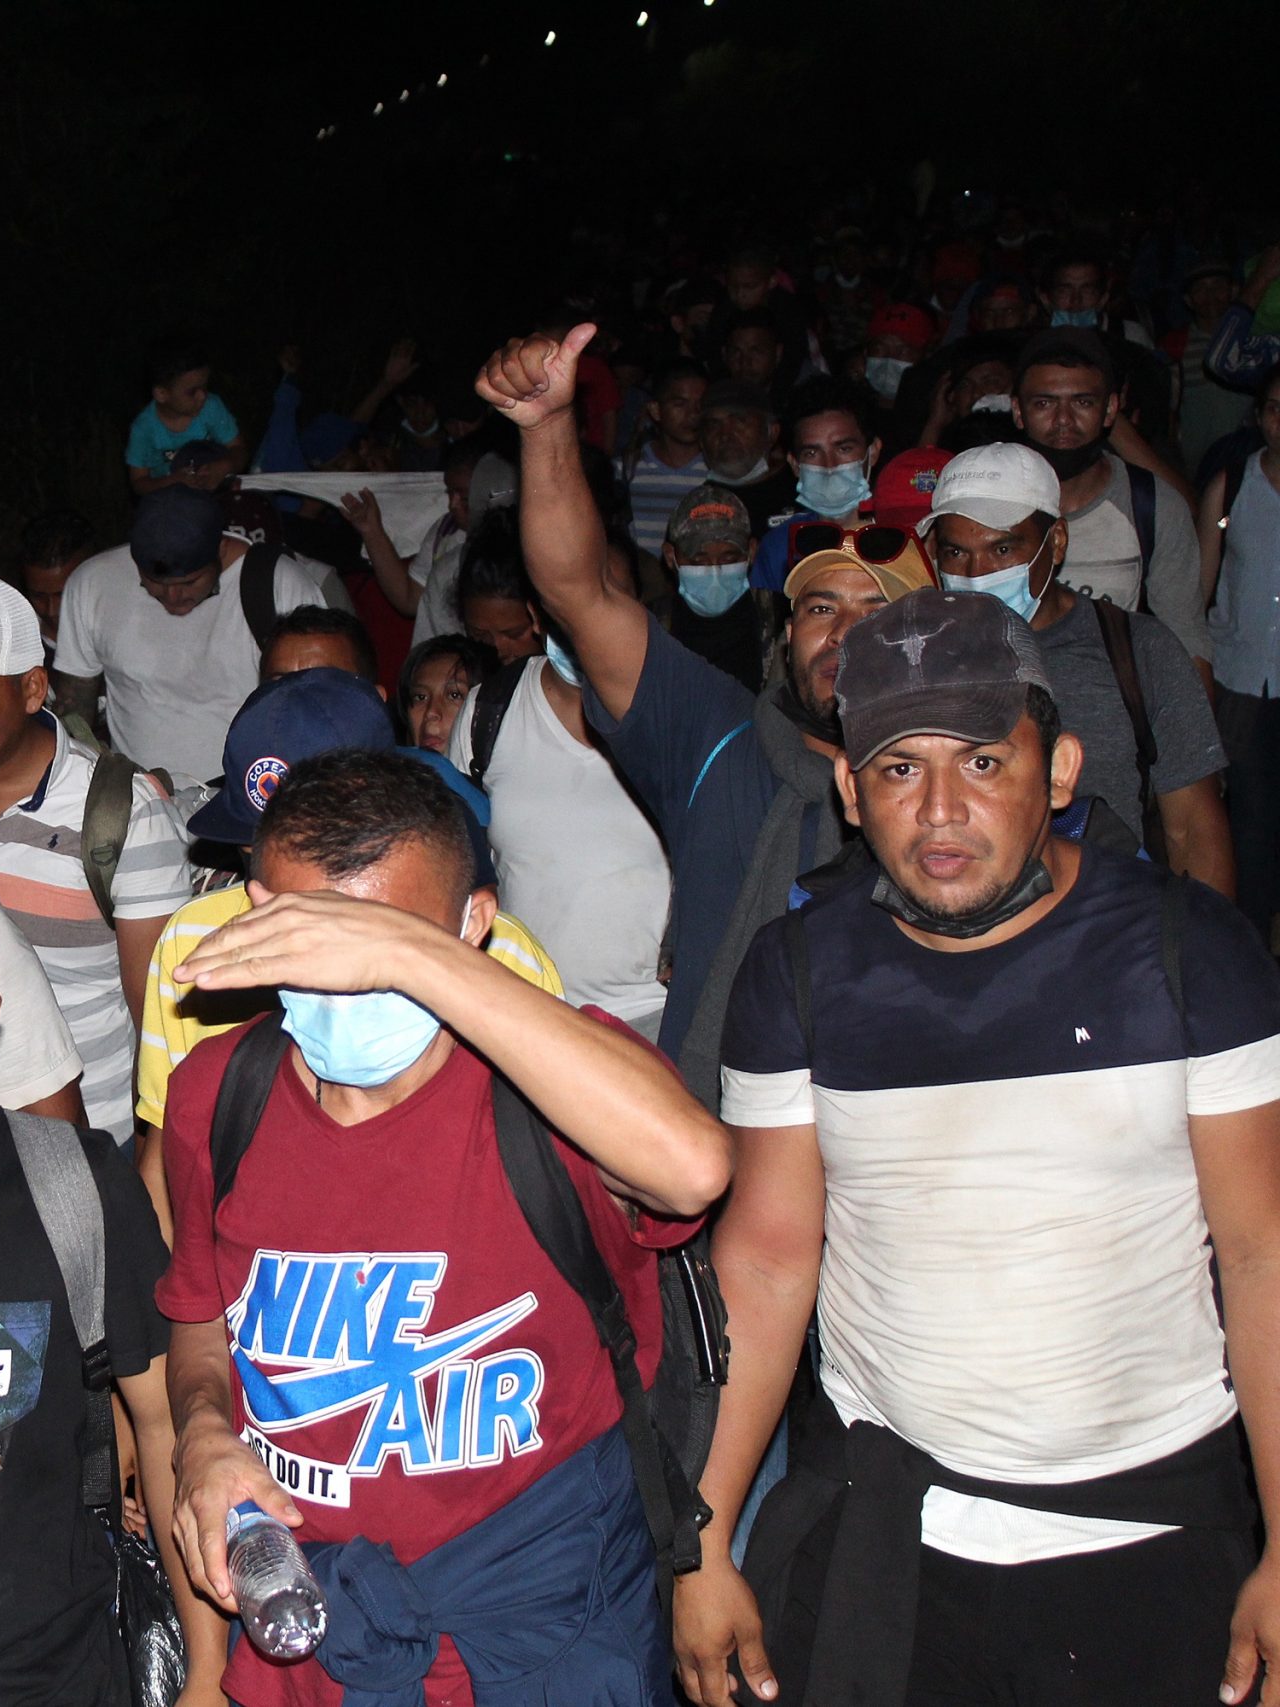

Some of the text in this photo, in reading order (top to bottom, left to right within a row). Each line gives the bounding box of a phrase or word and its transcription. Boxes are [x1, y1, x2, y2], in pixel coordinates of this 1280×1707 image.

[227, 1252, 447, 1364] NIKE
[350, 1351, 542, 1474] AIR
[276, 1452, 300, 1489] DO
[308, 1465, 337, 1499] IT.
